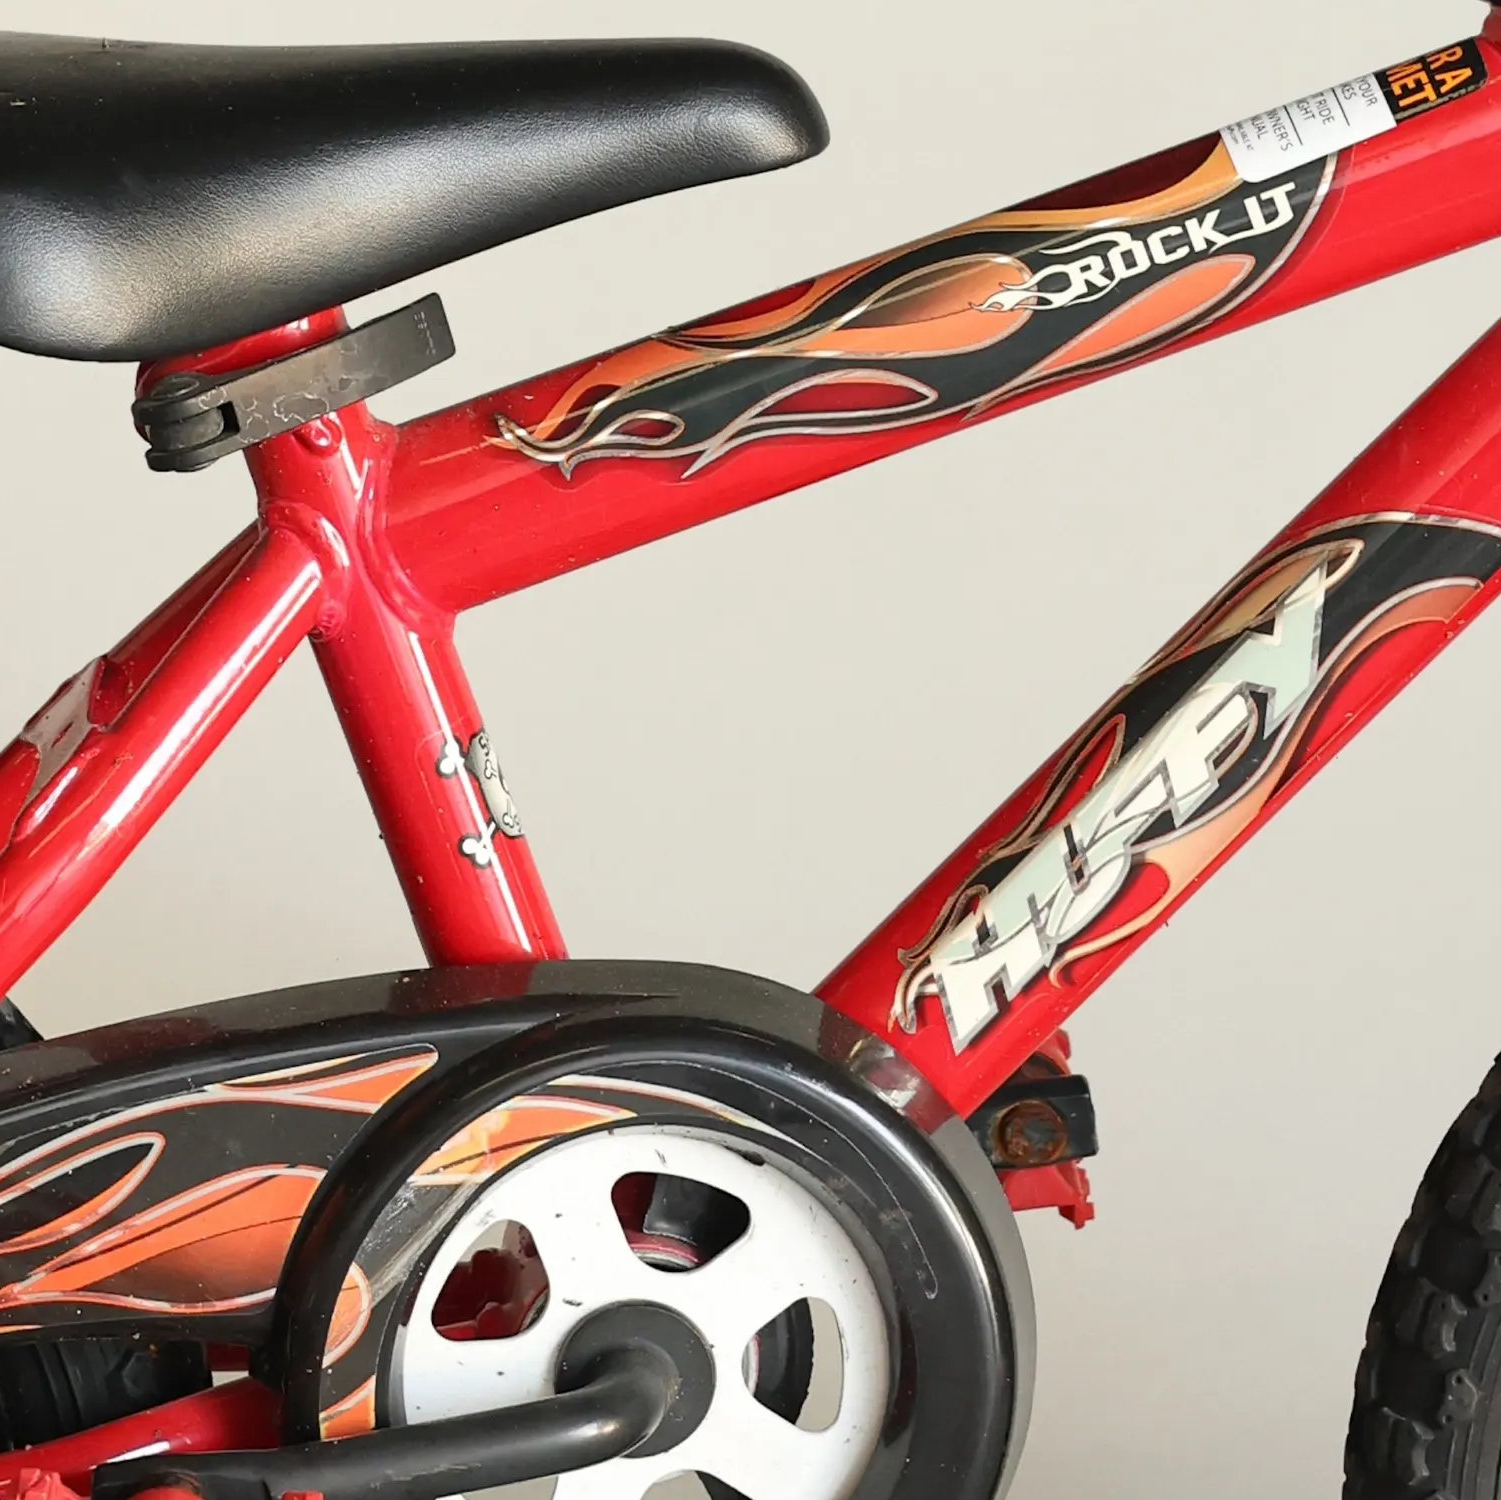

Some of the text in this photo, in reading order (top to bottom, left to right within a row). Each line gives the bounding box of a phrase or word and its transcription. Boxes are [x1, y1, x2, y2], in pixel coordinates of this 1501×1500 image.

[1356, 76, 1379, 108] YOUR
[1386, 62, 1437, 108] MET
[1266, 108, 1294, 152] WNER'S
[1314, 98, 1335, 126] RIDE
[1038, 181, 1296, 300] ROCK IT
[932, 550, 1328, 1056] HUFFY
